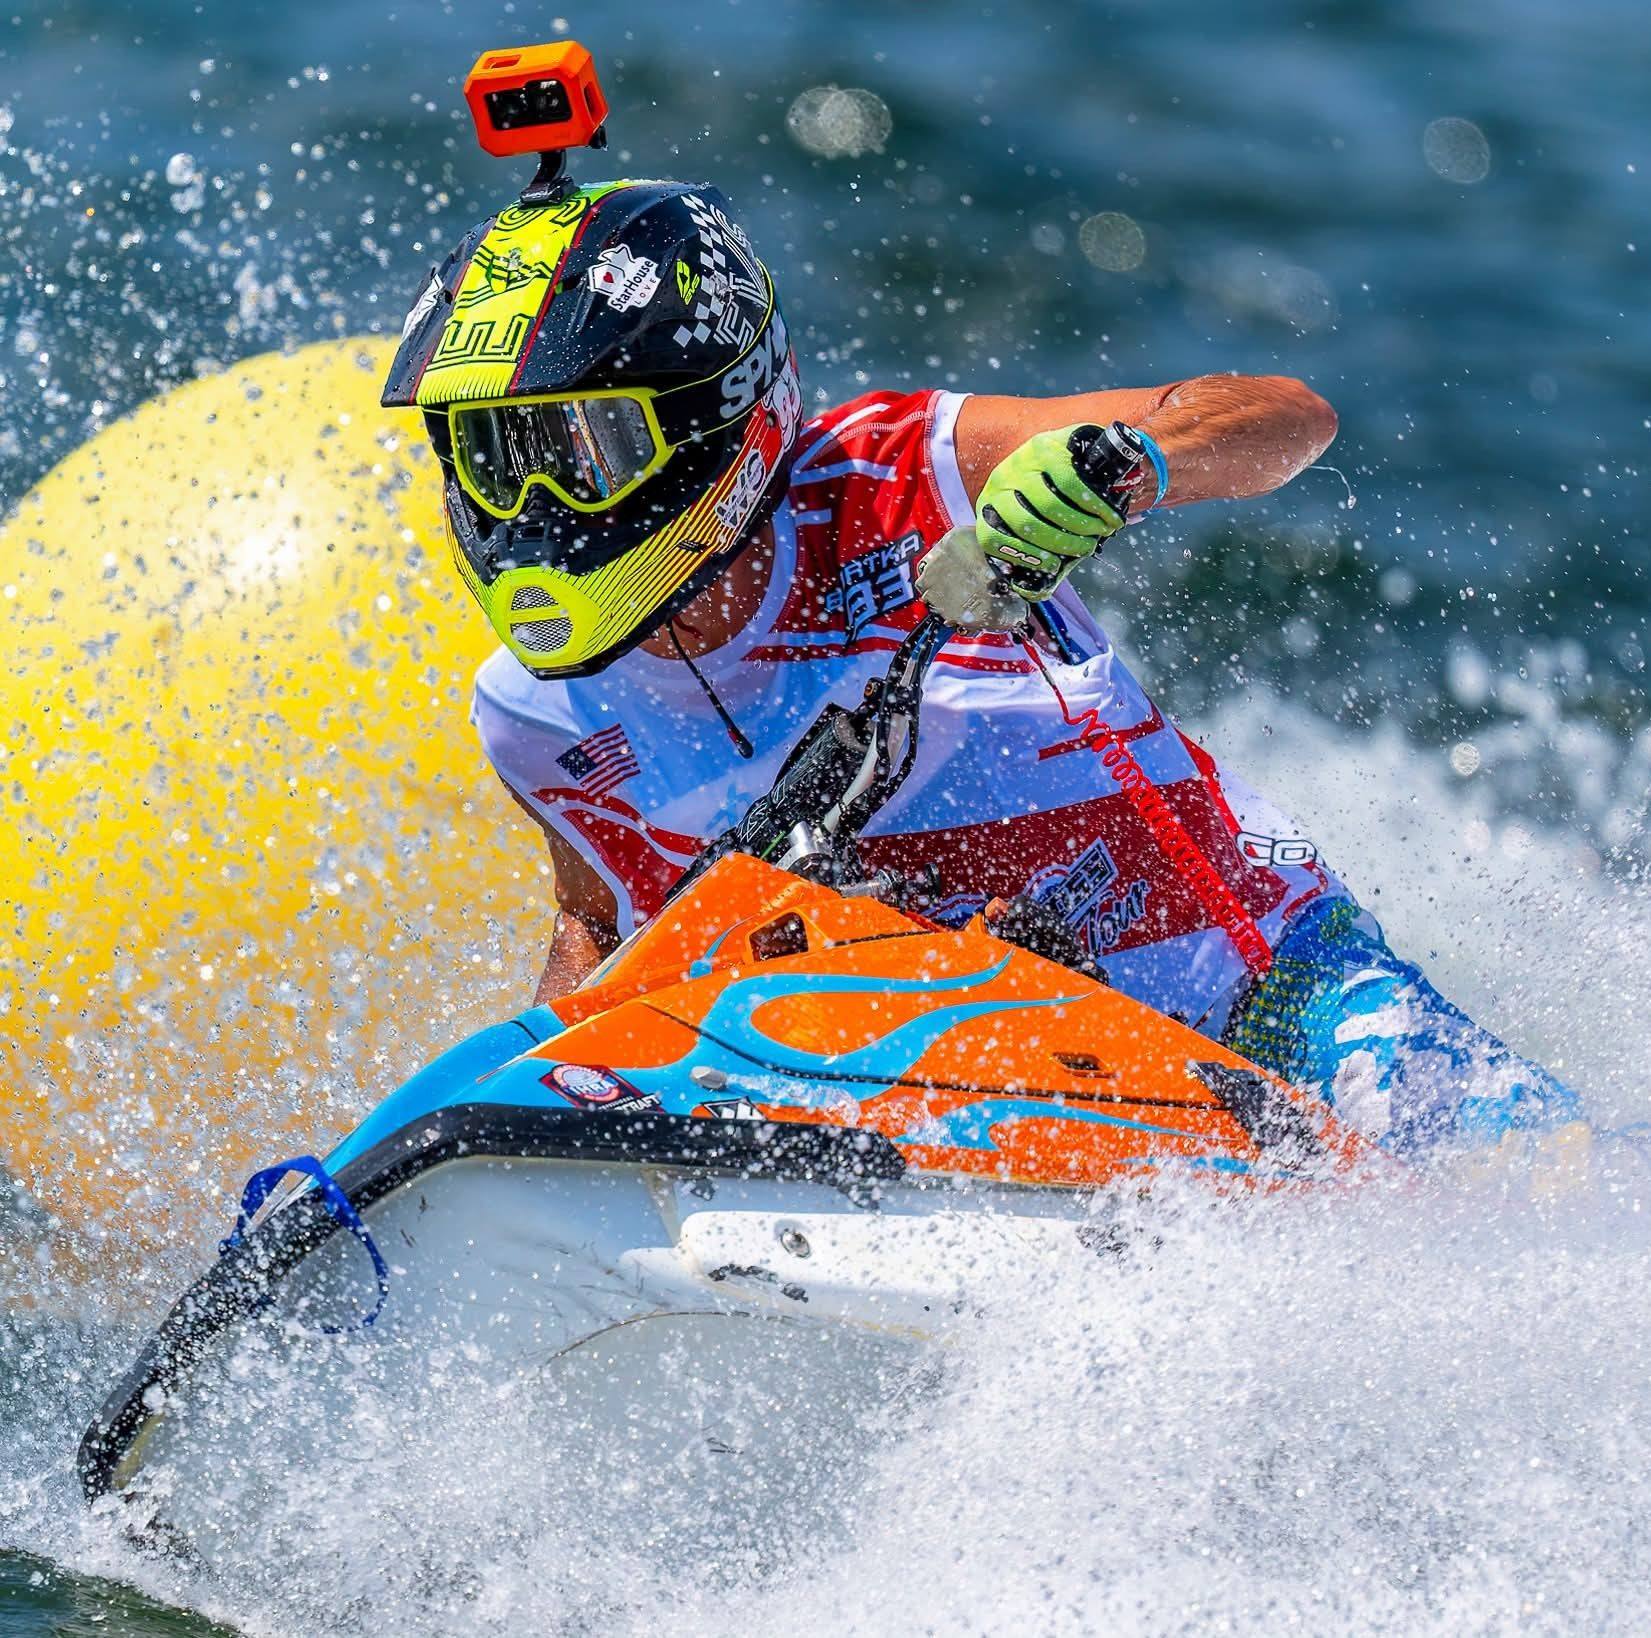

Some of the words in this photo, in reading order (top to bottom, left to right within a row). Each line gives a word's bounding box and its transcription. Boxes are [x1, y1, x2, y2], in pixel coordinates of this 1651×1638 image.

[611, 260, 655, 310] StarHouse
[635, 278, 657, 304] LOVE
[824, 533, 920, 614] BRTKA
